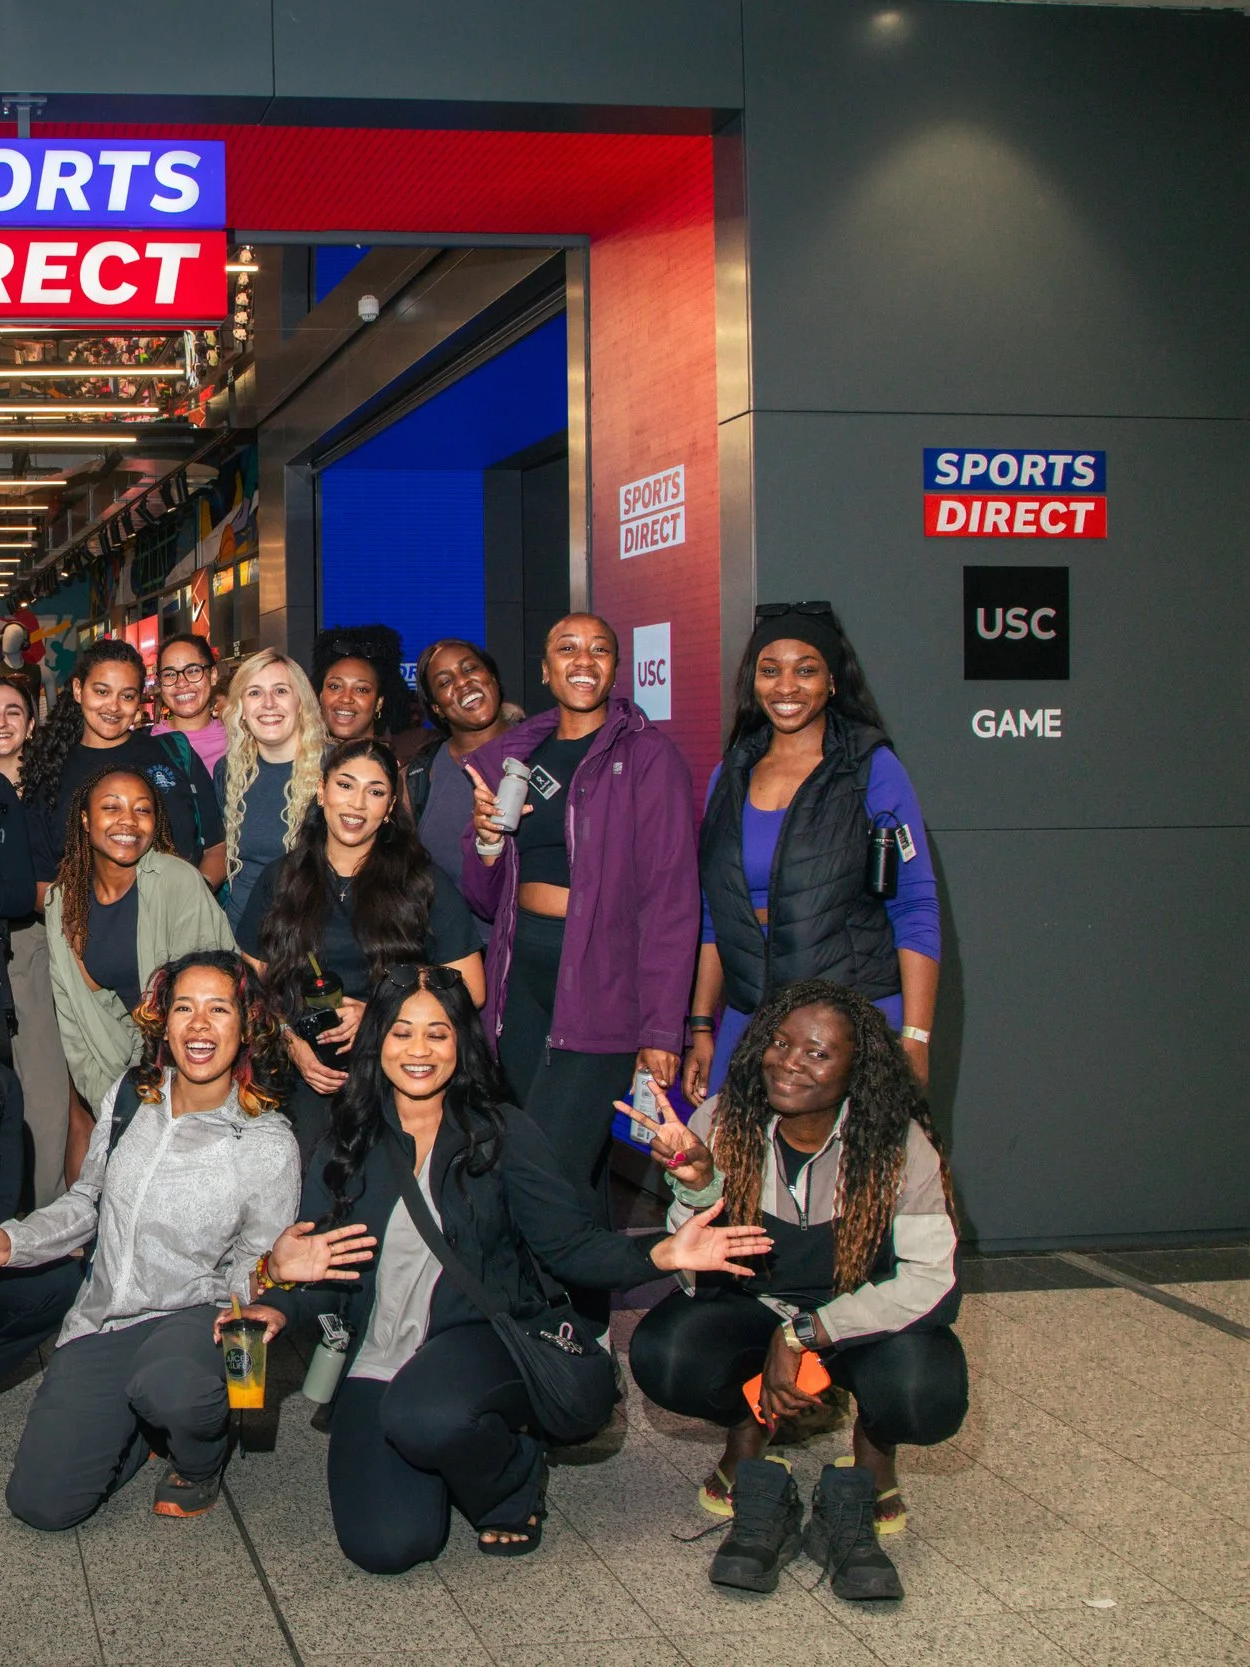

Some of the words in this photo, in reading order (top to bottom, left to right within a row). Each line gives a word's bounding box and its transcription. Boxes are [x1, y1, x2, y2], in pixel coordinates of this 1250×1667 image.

[934, 452, 1096, 487] SPORTS
[623, 471, 681, 516] SPORTS
[624, 511, 681, 554] DIRECT
[936, 500, 1096, 534] DIRECT
[976, 607, 1057, 640] USC
[637, 658, 667, 687] USC
[971, 708, 1062, 738] GAME
